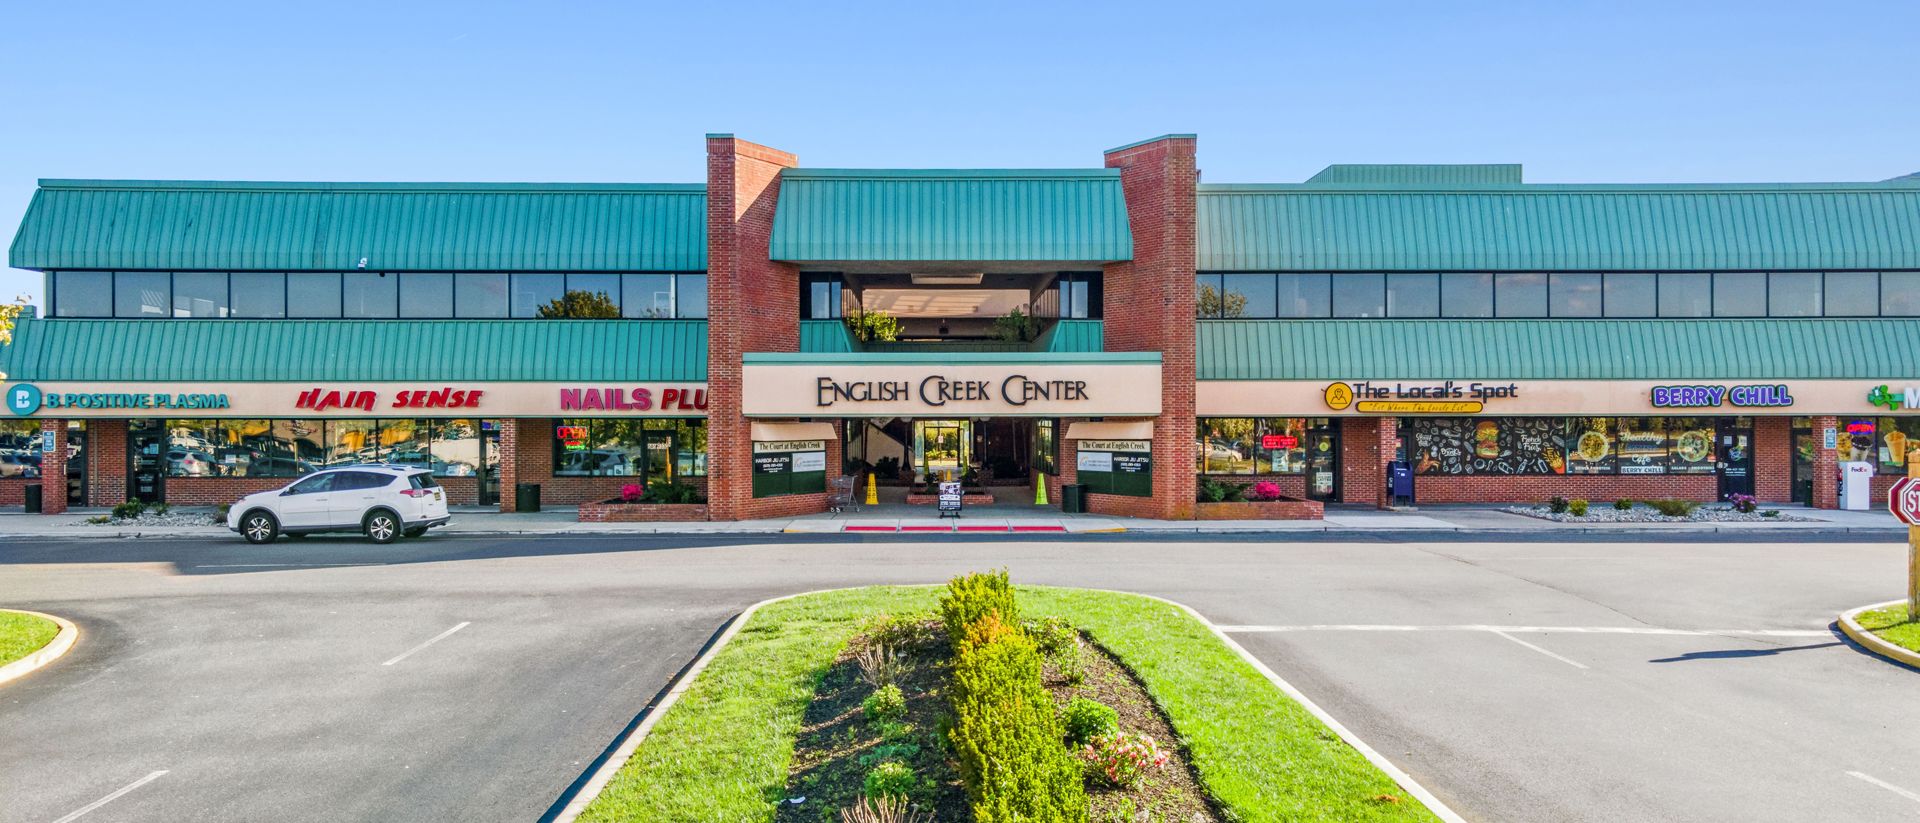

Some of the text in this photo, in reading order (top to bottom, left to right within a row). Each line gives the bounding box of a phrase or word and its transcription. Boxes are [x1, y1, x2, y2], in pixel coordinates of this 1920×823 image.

[295, 387, 484, 412] HAIR SENSE
[560, 387, 652, 411] NAILS
[1353, 381, 1518, 404] The Local's Spot
[1652, 384, 1794, 407] BERRY CHILL
[46, 393, 230, 409] B POSITIVE PLASMA
[557, 427, 587, 439] OPEN
[1846, 424, 1875, 433] OPEN
[760, 442, 768, 450] The
[769, 442, 784, 450] Court
[790, 441, 807, 450] English
[807, 441, 821, 449] Creek
[1082, 441, 1091, 449] The
[1091, 441, 1106, 449] Court
[1111, 442, 1130, 450] English
[1130, 442, 1145, 450] Creek
[1618, 432, 1664, 445] Healthy
